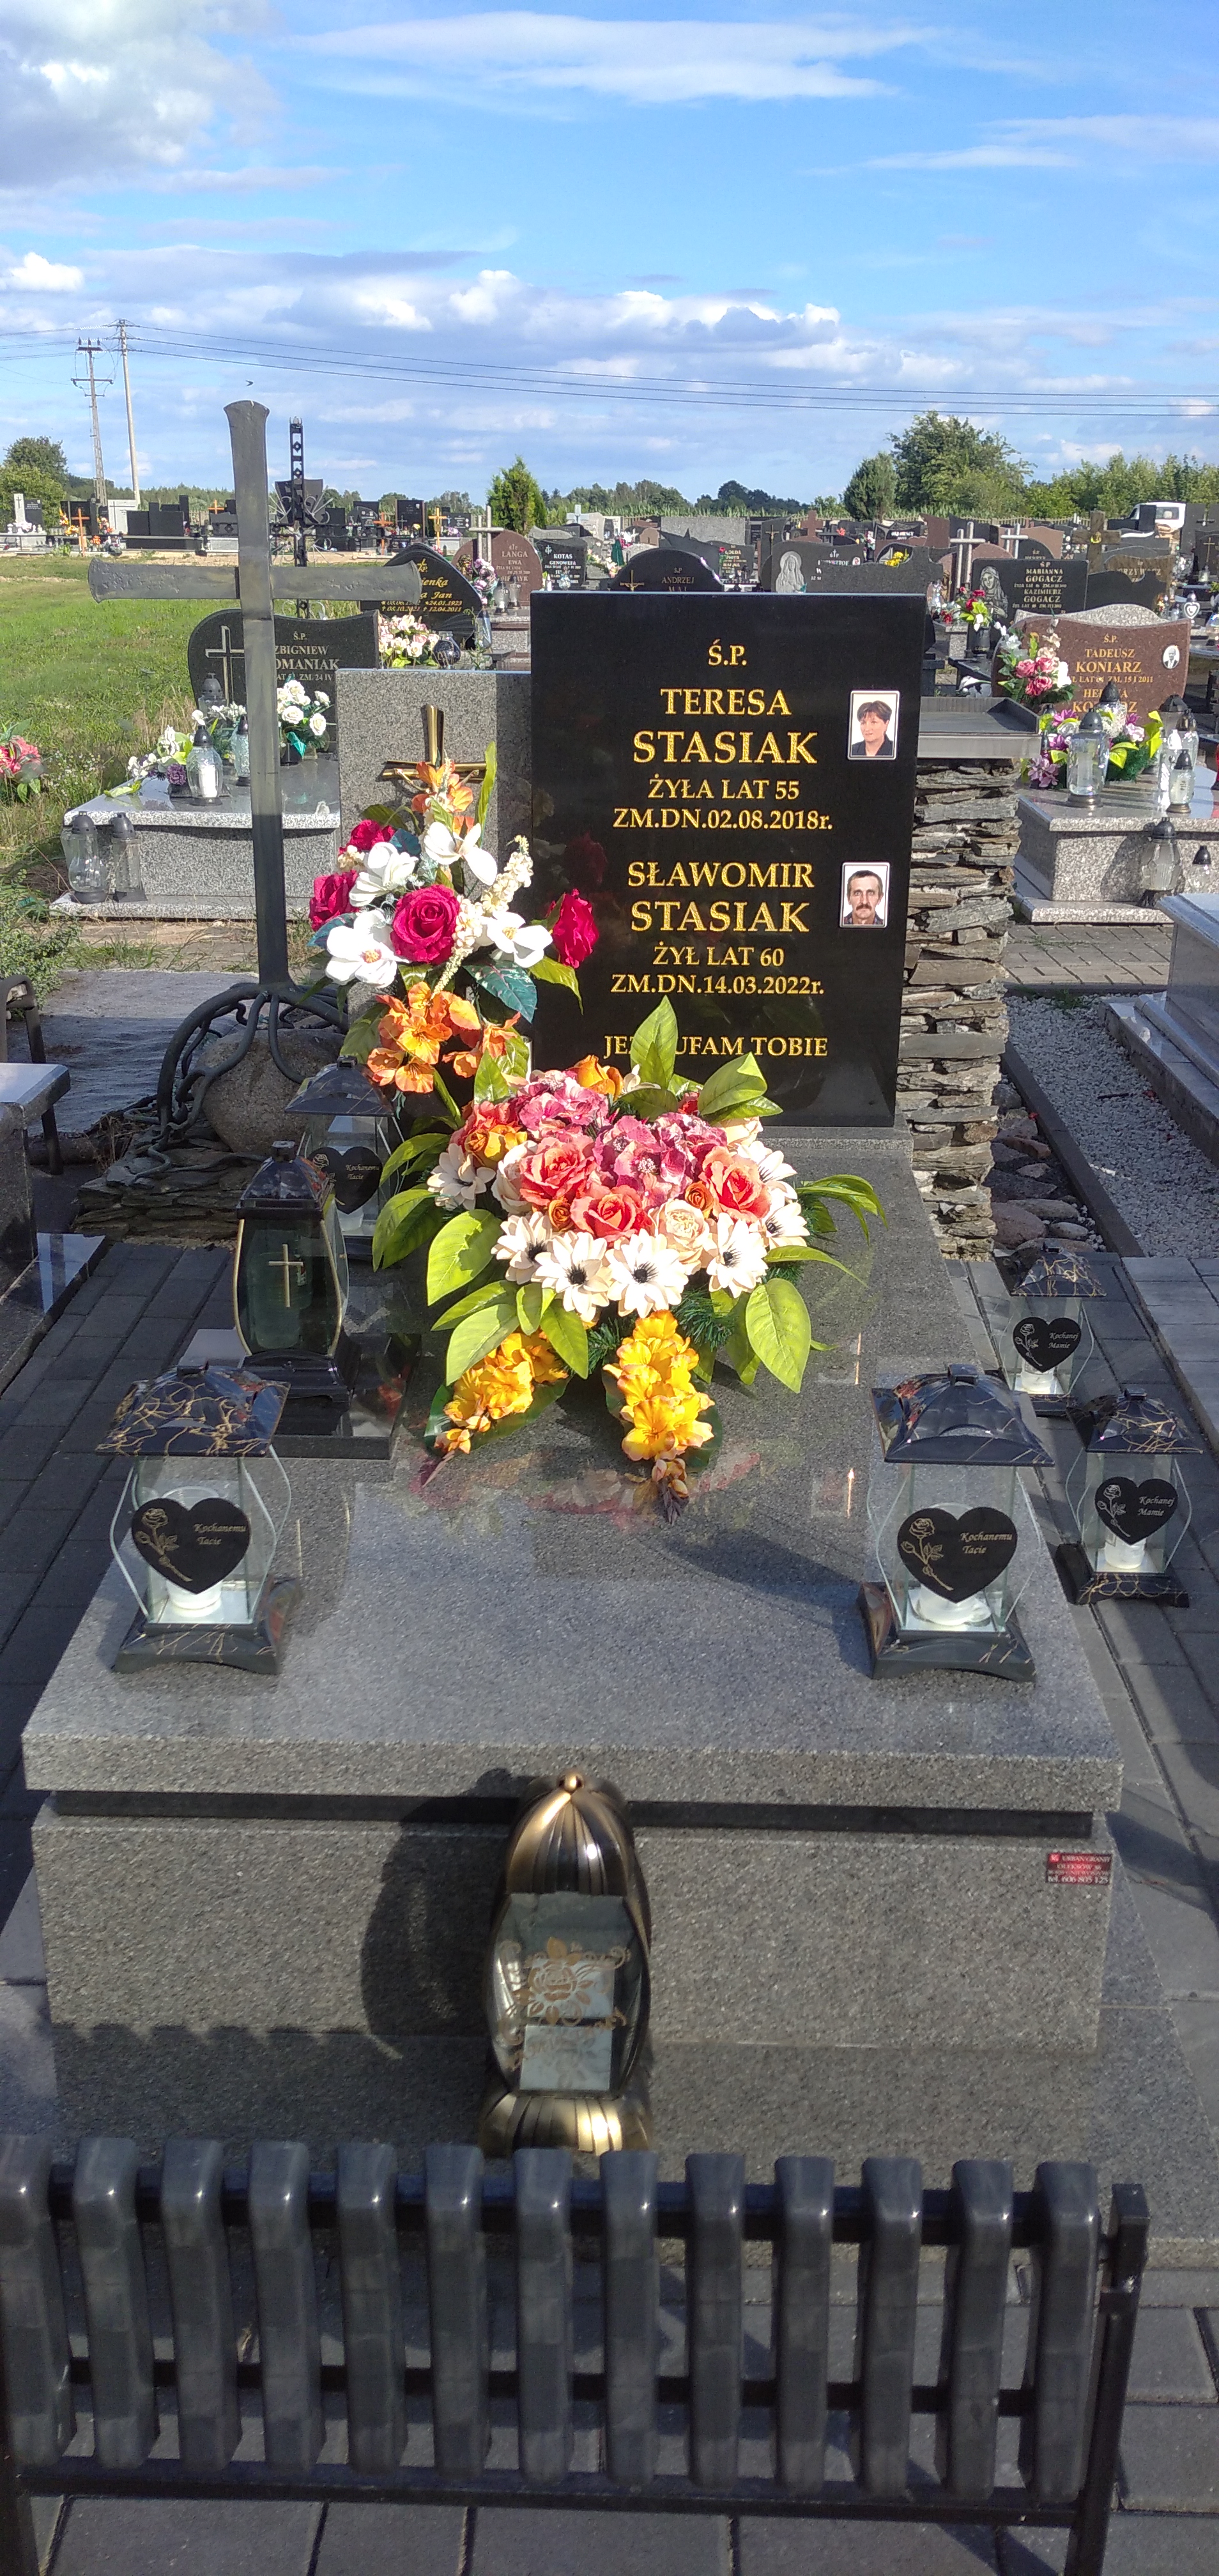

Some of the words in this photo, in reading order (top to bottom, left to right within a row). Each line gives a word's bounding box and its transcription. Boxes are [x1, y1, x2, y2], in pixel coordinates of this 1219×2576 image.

[275, 645, 329, 655] ZBIGNIEW
[708, 638, 747, 666] Ś.P.
[1085, 648, 1135, 658] TADEUSZ
[1076, 661, 1142, 673] KONIARZ
[660, 689, 792, 716] TERESA
[632, 731, 818, 763] STASIAK
[648, 773, 714, 799] ŻYŁA
[721, 779, 769, 799] LAT
[774, 780, 800, 800] 55
[613, 808, 833, 830] ZM.DN.02.08.2018r.
[627, 861, 815, 888] SŁAWOMIR
[631, 901, 810, 932] STASIAK
[652, 941, 700, 965] ŻYŁ
[707, 946, 755, 966] LAT
[760, 947, 785, 967] 60
[610, 974, 825, 994] ZM.DN.14.03.2022r.
[675, 1036, 744, 1055] UFAM
[751, 1037, 828, 1056] TOBIE
[1048, 1332, 1079, 1341] Kochanej
[1138, 1496, 1175, 1507] Kochanej
[1137, 1508, 1165, 1517] Mamie
[194, 1523, 247, 1533] Kochanemu
[196, 1537, 222, 1545] Tacie
[960, 1531, 1013, 1542] Kochanemu
[962, 1545, 987, 1554] Tacie
